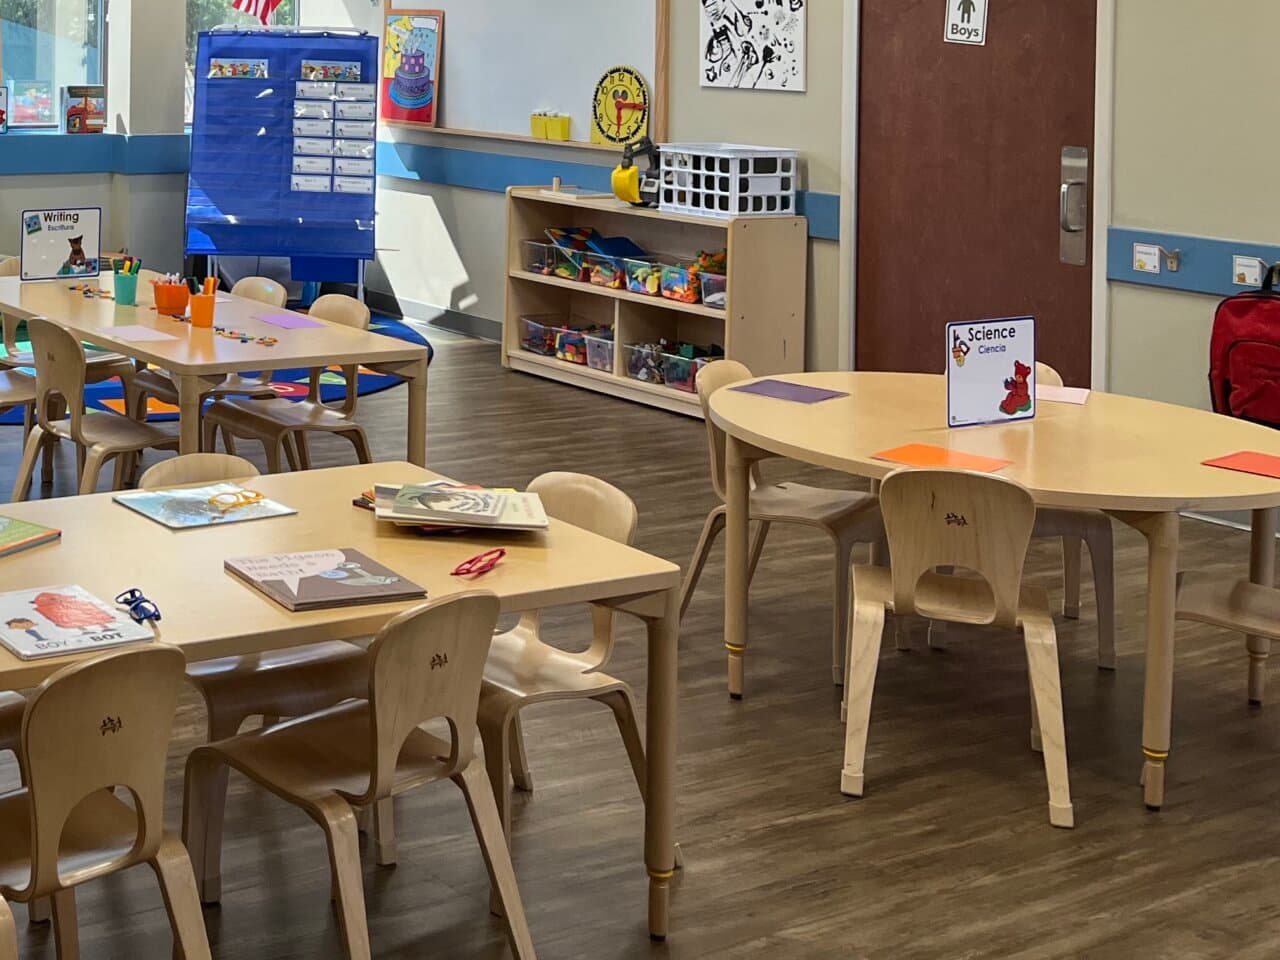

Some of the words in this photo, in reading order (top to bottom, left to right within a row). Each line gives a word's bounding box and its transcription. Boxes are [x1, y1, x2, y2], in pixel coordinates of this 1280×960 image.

[951, 24, 979, 39] Boys
[619, 73, 624, 81] 12
[636, 88, 640, 97] 2
[44, 211, 79, 223] Writing
[968, 326, 1016, 342] Science
[978, 344, 1006, 354] Ciencia
[35, 640, 67, 649] BOY
[90, 632, 123, 642] BOT
